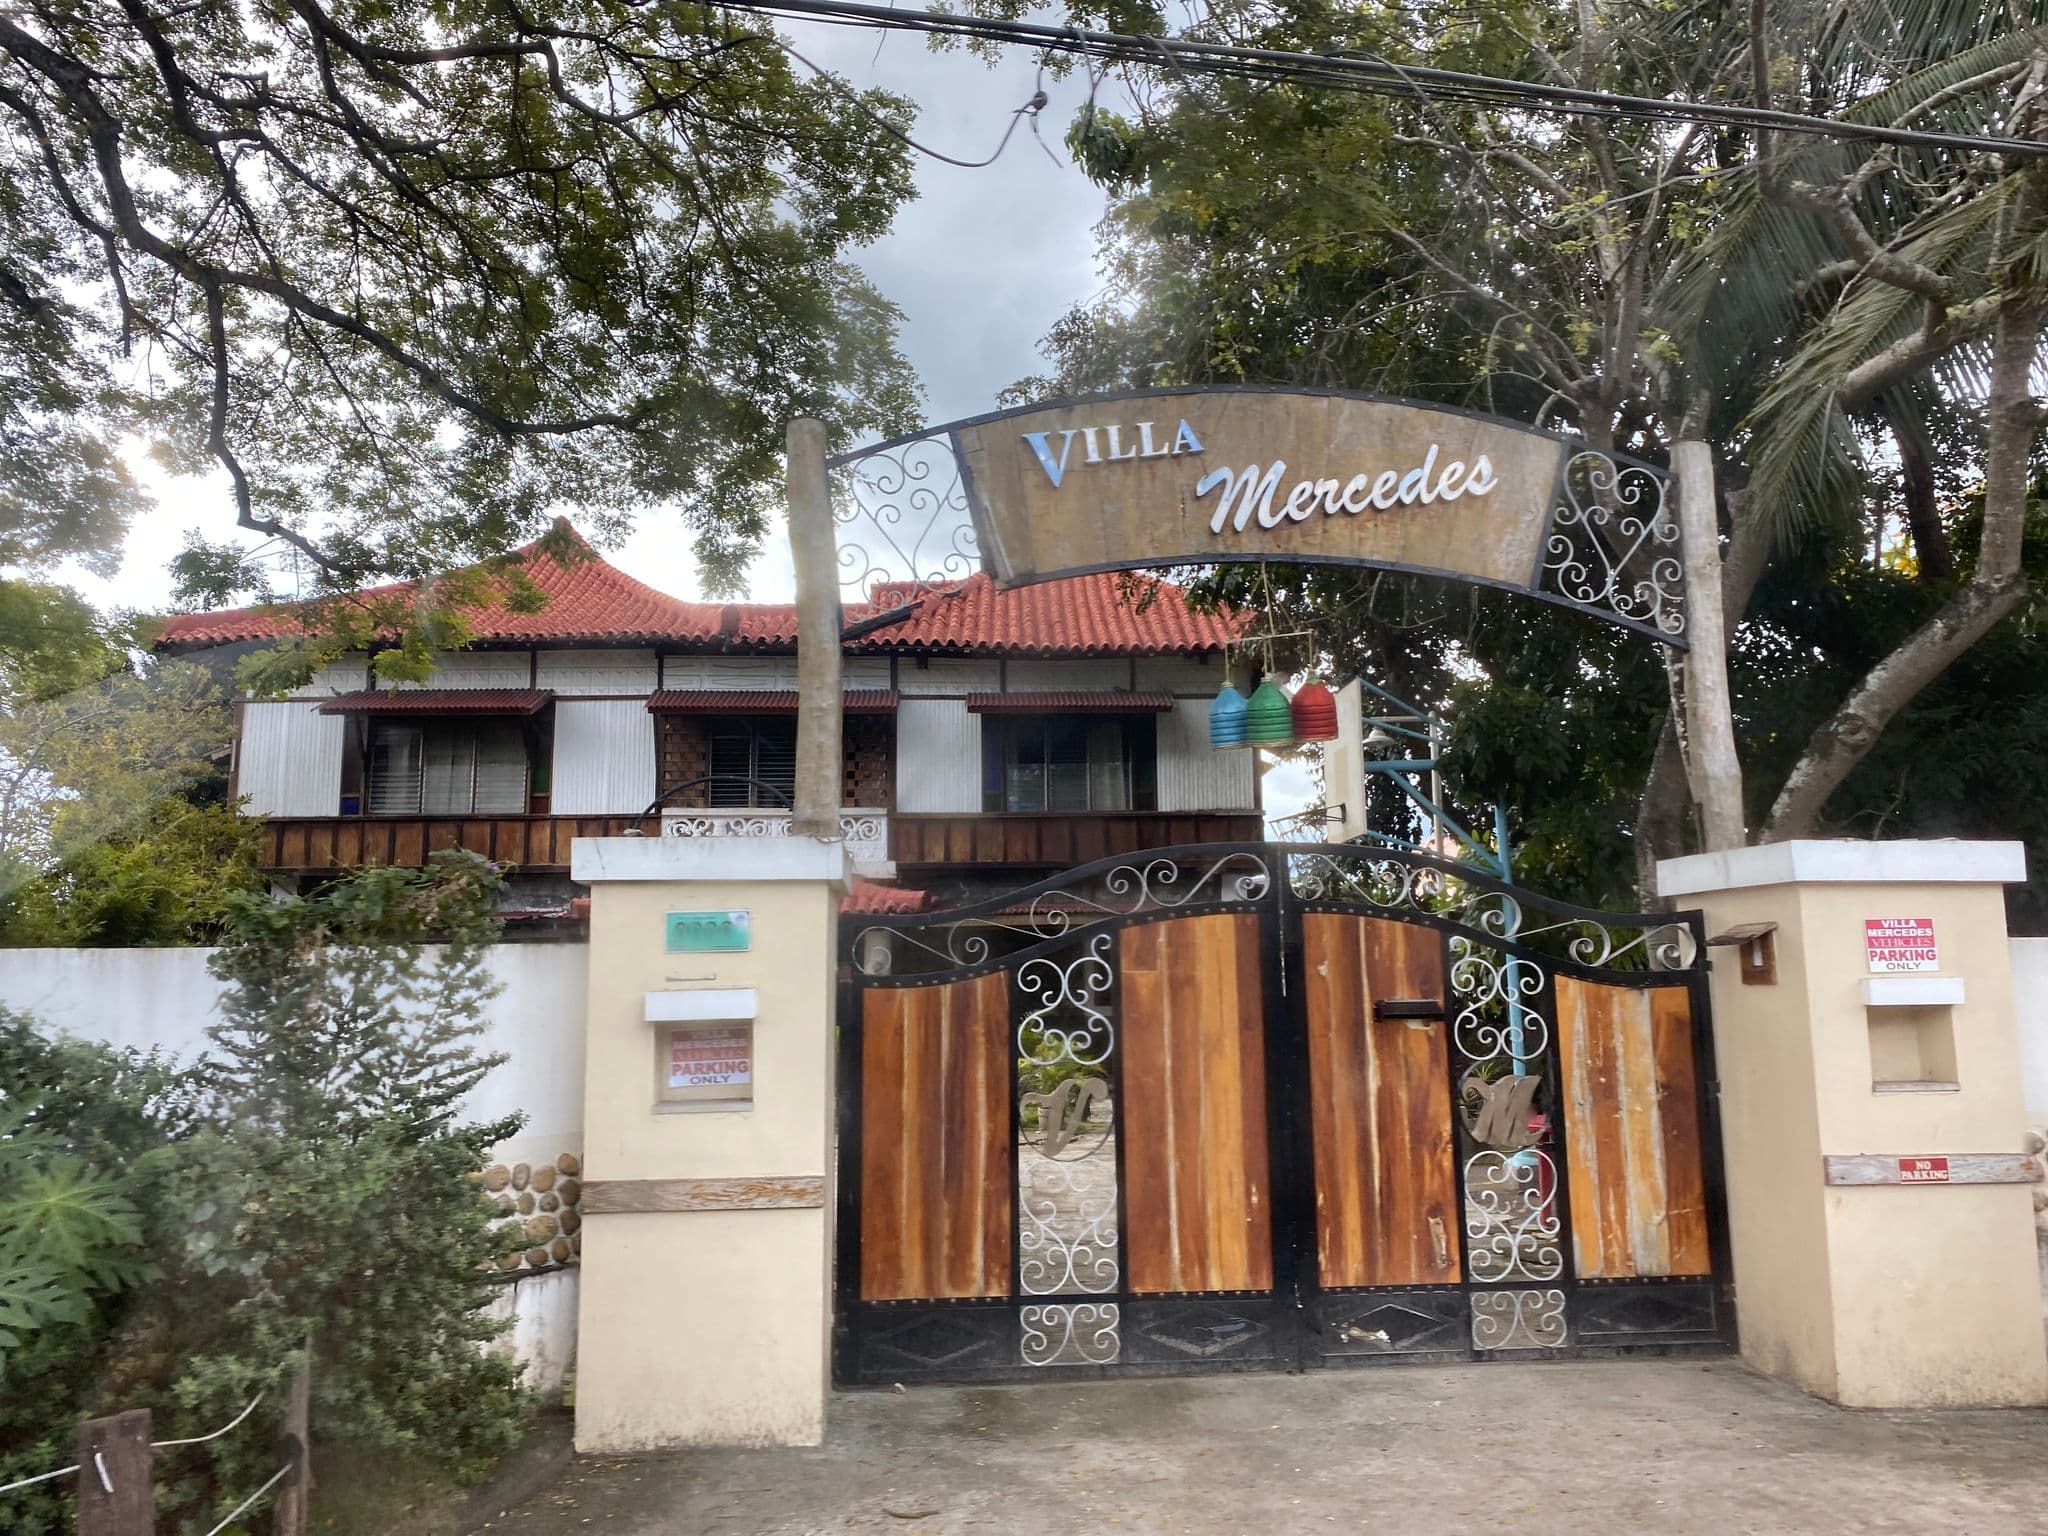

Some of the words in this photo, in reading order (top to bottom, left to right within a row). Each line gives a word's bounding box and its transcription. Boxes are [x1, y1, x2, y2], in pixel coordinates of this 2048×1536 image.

[1021, 418, 1205, 488] VILLA
[1196, 444, 1498, 534] Mercedes
[1881, 920, 1917, 928] VILLA
[1867, 928, 1932, 937] MERCEDES
[1871, 938, 1932, 947] VEHICLES
[1869, 949, 1936, 961] PARKING
[1886, 962, 1921, 970] ONLY
[671, 1060, 749, 1076] PARKING
[689, 1075, 731, 1085] ONLY
[1915, 1160, 1931, 1170] NO
[1901, 1170, 1948, 1180] PARKING
